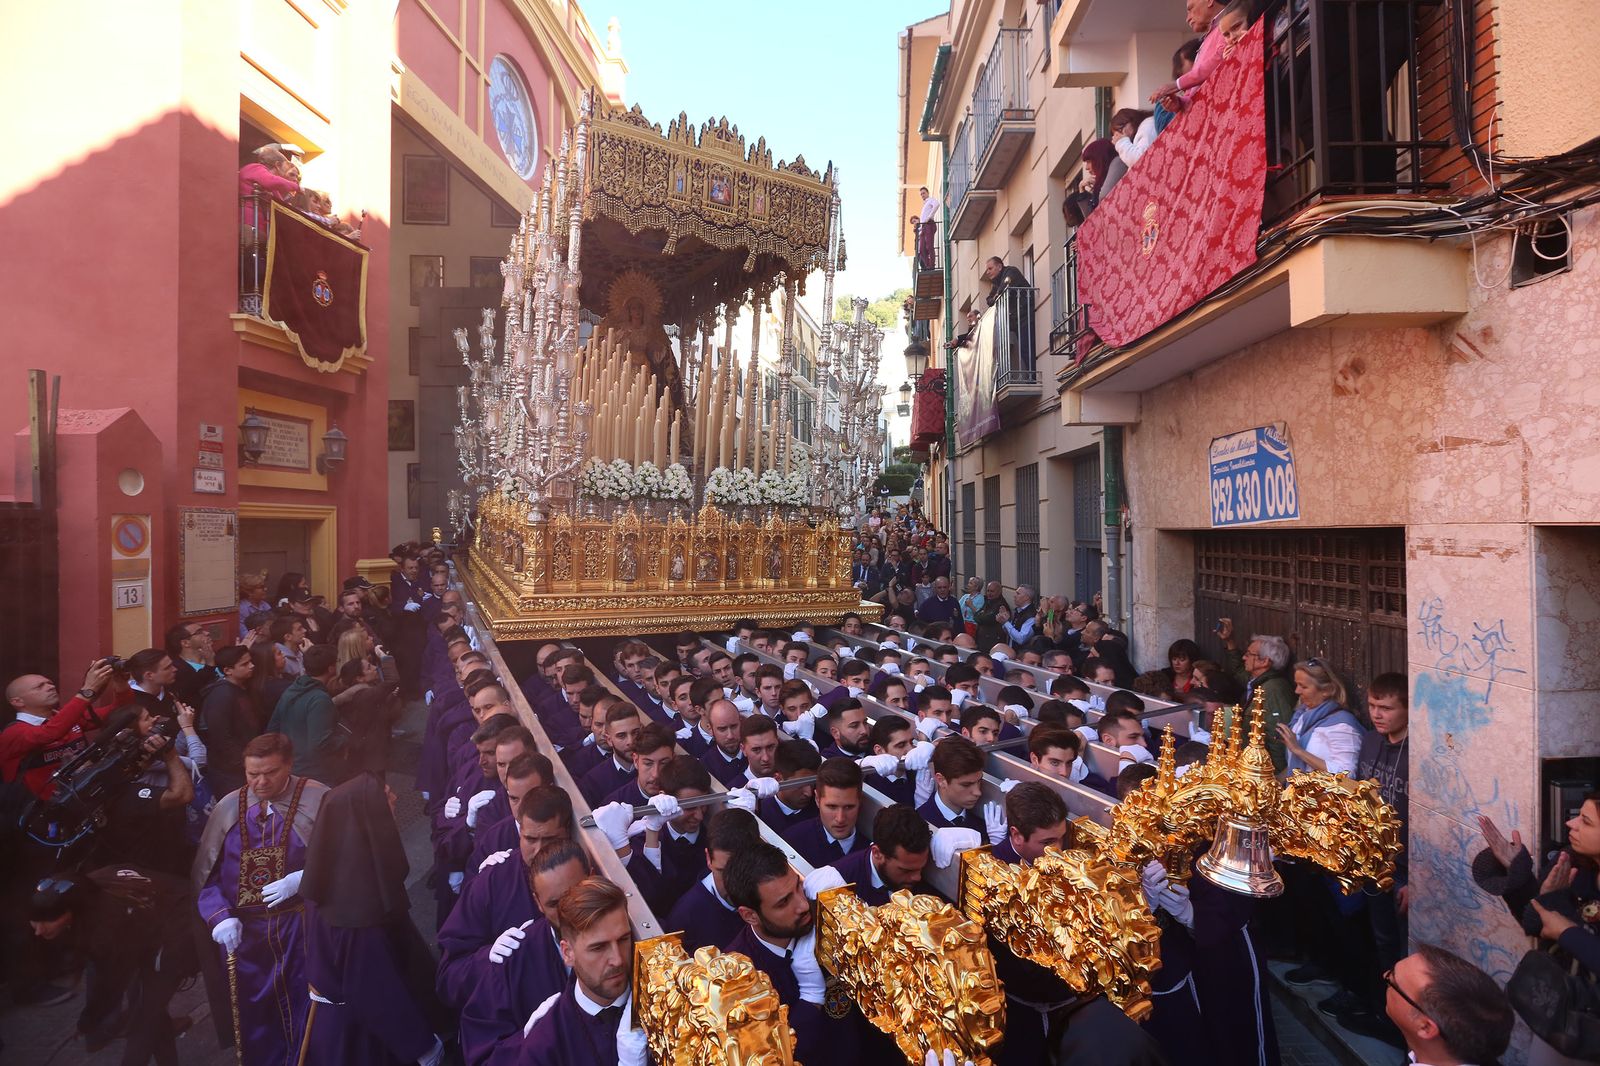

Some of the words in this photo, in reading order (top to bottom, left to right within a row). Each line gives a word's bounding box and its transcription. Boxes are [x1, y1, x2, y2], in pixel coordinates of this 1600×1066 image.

[406, 84, 429, 113] EGO
[431, 107, 453, 137] SVM
[1212, 476, 1234, 523] 952
[1235, 470, 1261, 520] 330
[1264, 463, 1296, 517] 008
[124, 588, 138, 605] 13
